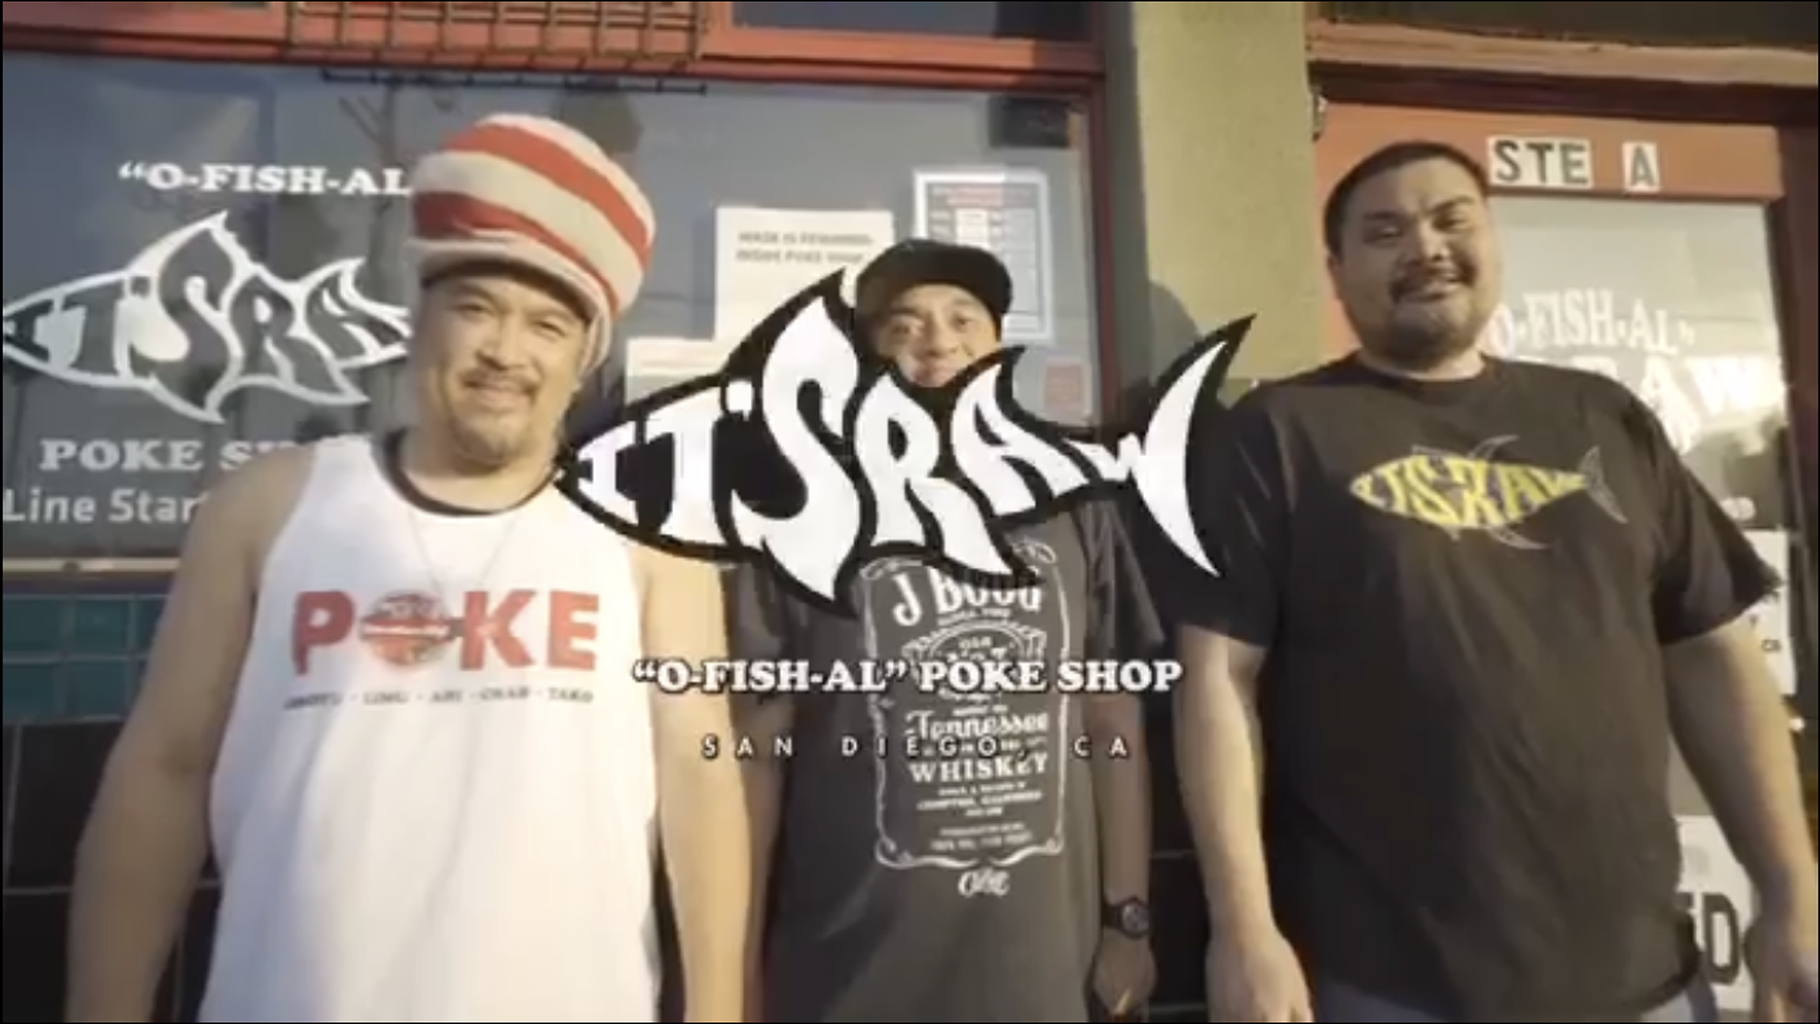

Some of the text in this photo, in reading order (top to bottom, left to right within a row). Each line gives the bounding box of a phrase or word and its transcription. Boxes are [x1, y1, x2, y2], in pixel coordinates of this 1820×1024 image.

[1493, 138, 1656, 188] STE A
[39, 438, 204, 471] POKE
[3, 488, 96, 523] Line
[892, 572, 923, 627] J
[910, 751, 1050, 783] WHISKEY
